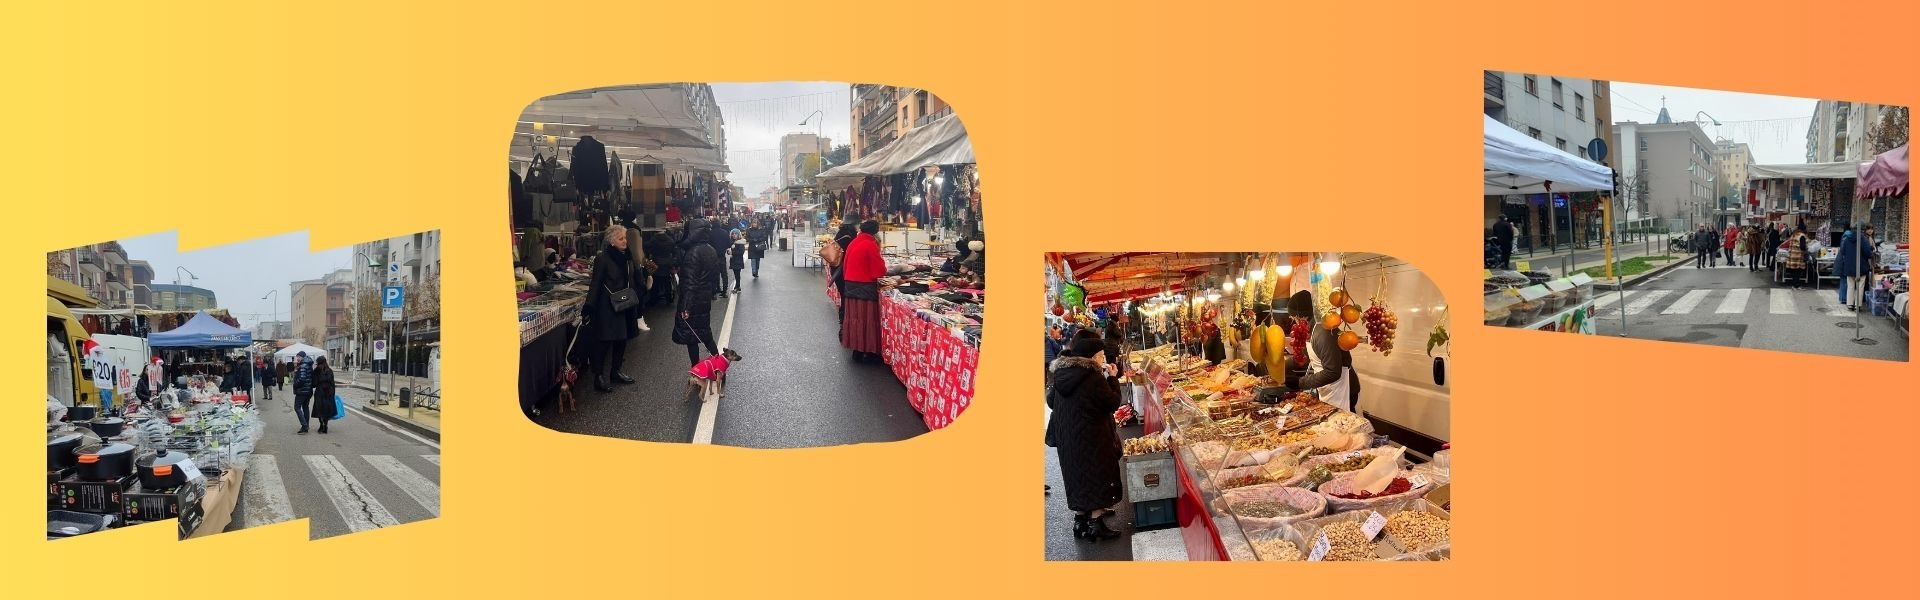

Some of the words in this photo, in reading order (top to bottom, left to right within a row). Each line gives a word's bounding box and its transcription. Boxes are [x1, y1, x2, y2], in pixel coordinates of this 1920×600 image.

[386, 288, 400, 305] P
[93, 360, 111, 380] €20
[119, 369, 131, 388] €15
